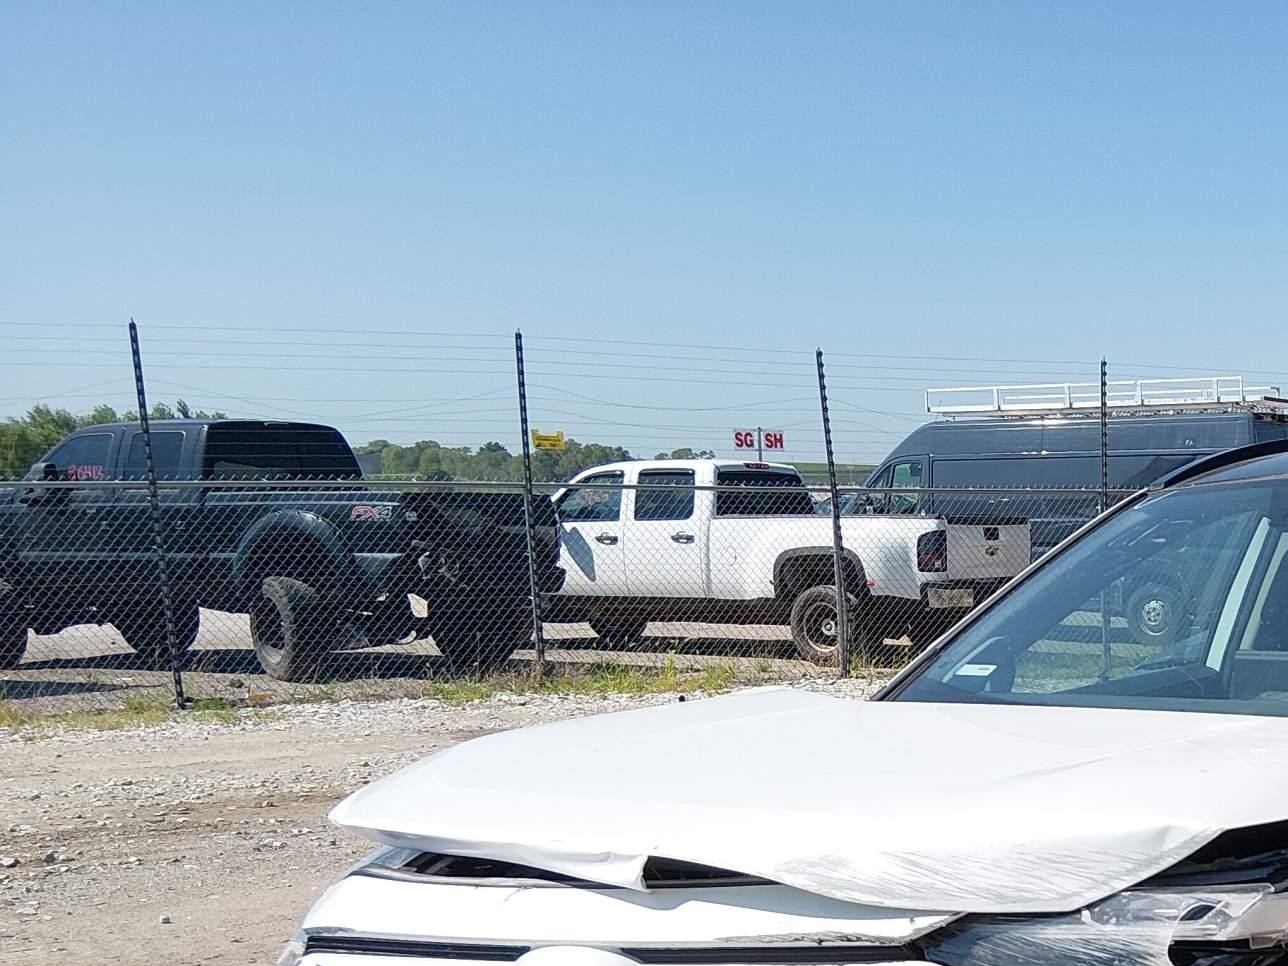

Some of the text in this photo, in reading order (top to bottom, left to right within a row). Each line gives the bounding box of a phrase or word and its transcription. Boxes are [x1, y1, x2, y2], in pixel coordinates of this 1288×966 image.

[734, 431, 755, 448] SG
[764, 432, 784, 449] SH
[351, 505, 393, 519] FX4
